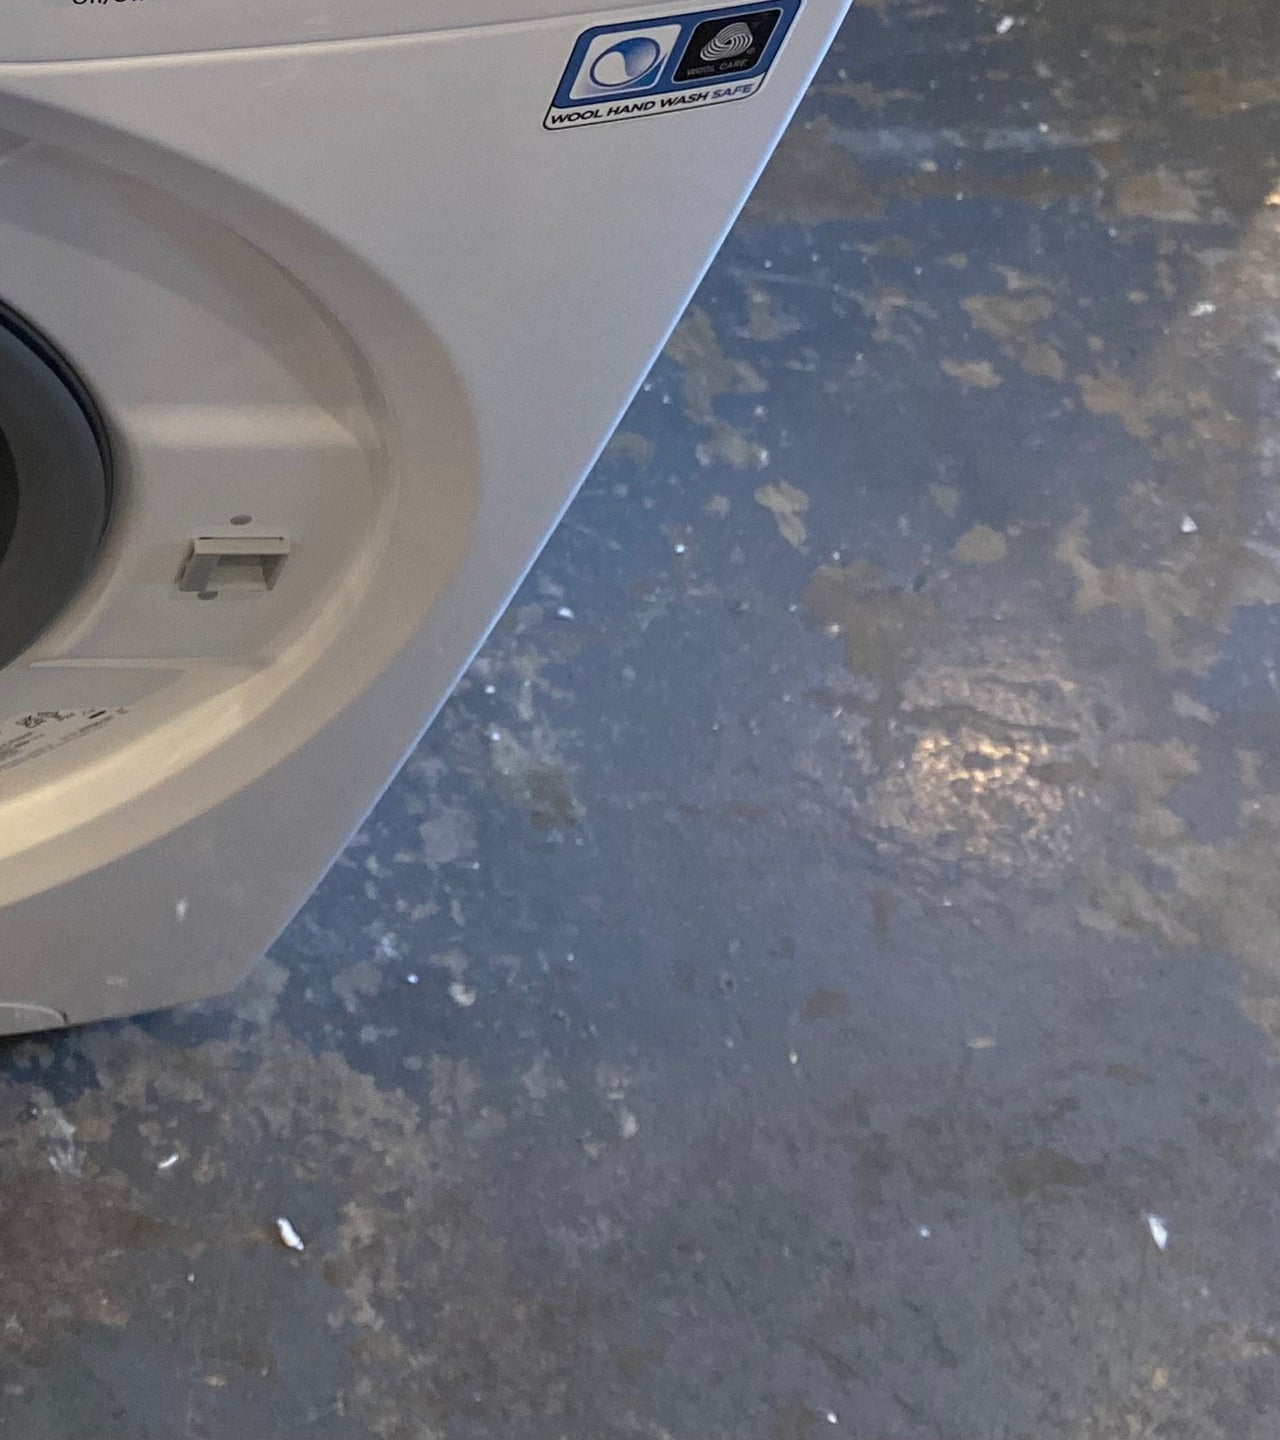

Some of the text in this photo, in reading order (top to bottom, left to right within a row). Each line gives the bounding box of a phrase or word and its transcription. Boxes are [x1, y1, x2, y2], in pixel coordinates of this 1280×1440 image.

[551, 83, 754, 124] WOOL HAND WASH SAFE
